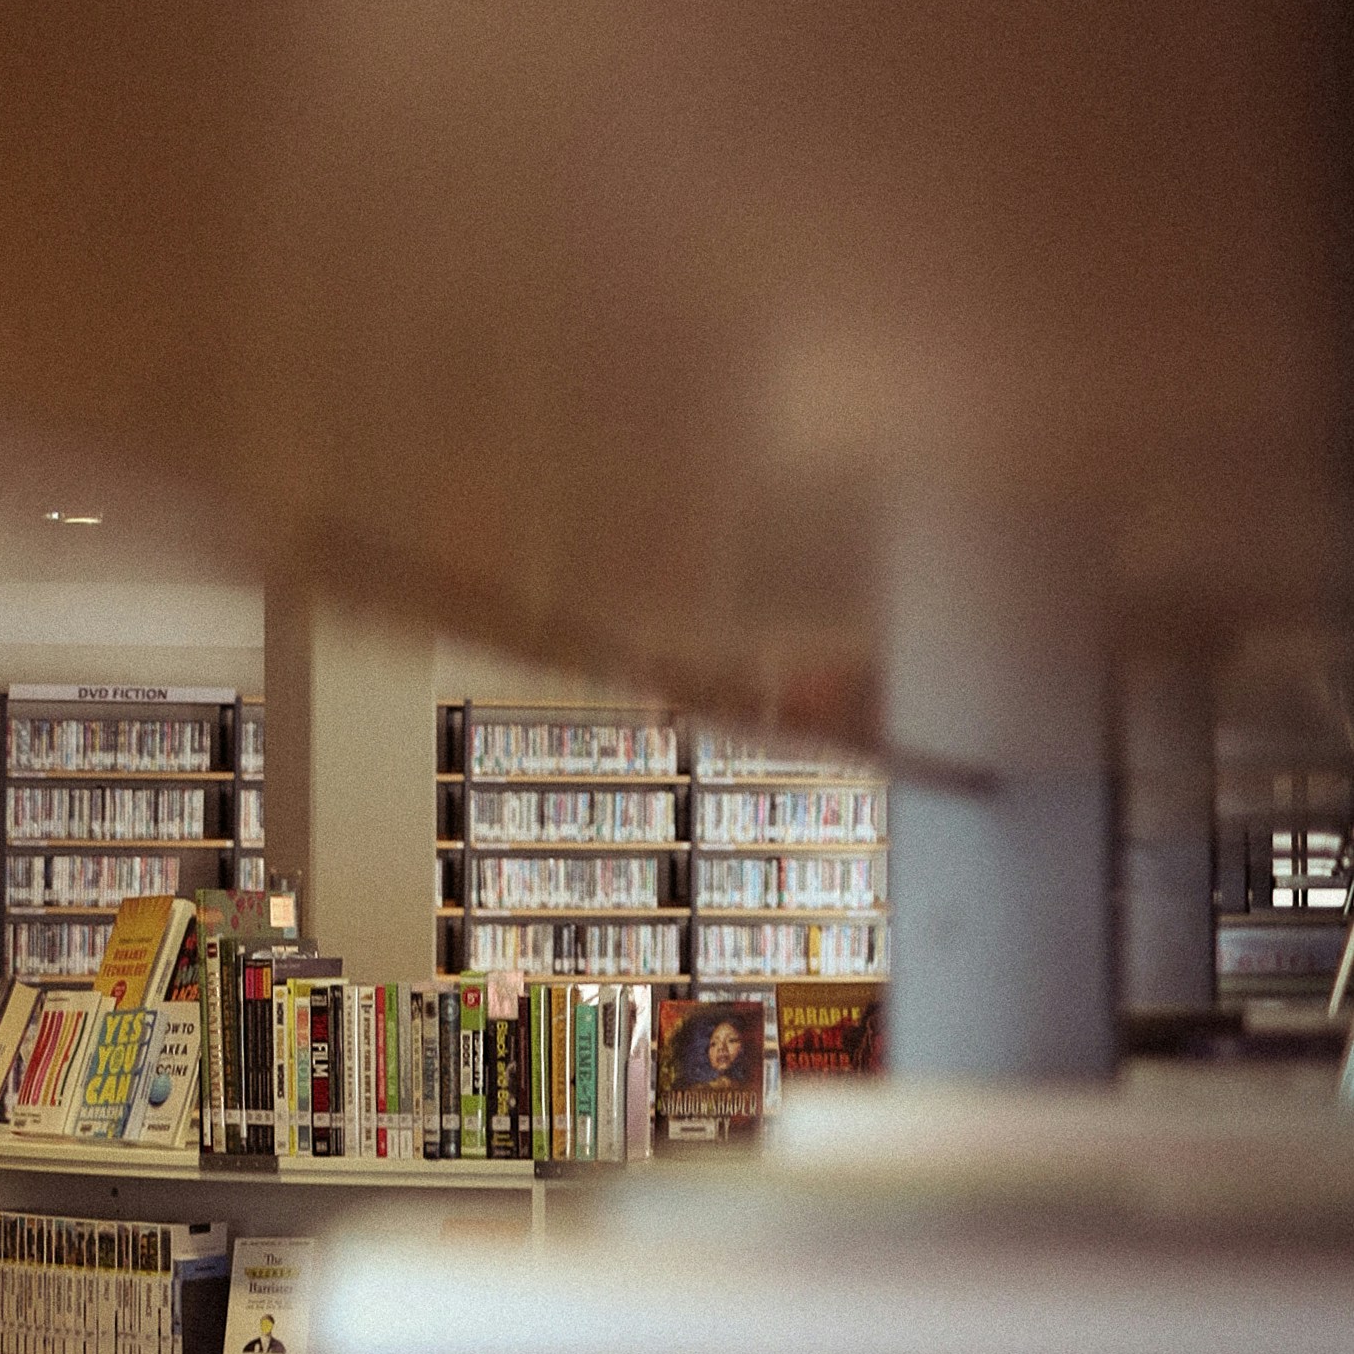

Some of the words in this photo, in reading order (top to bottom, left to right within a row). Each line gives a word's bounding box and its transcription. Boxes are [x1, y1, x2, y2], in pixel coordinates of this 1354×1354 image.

[77, 687, 109, 700] DVD
[112, 688, 168, 701] FICTION
[104, 1011, 146, 1044] YES
[182, 1022, 195, 1036] TO
[277, 1002, 285, 1026] HOW
[462, 1033, 471, 1068] BOOK
[496, 1020, 509, 1058] Black
[578, 1032, 592, 1079] TIME
[97, 1043, 138, 1076] YOU
[313, 1042, 329, 1078] FILM
[496, 1060, 509, 1088] and
[85, 1073, 132, 1106] CAN
[277, 1063, 285, 1100] WORKS
